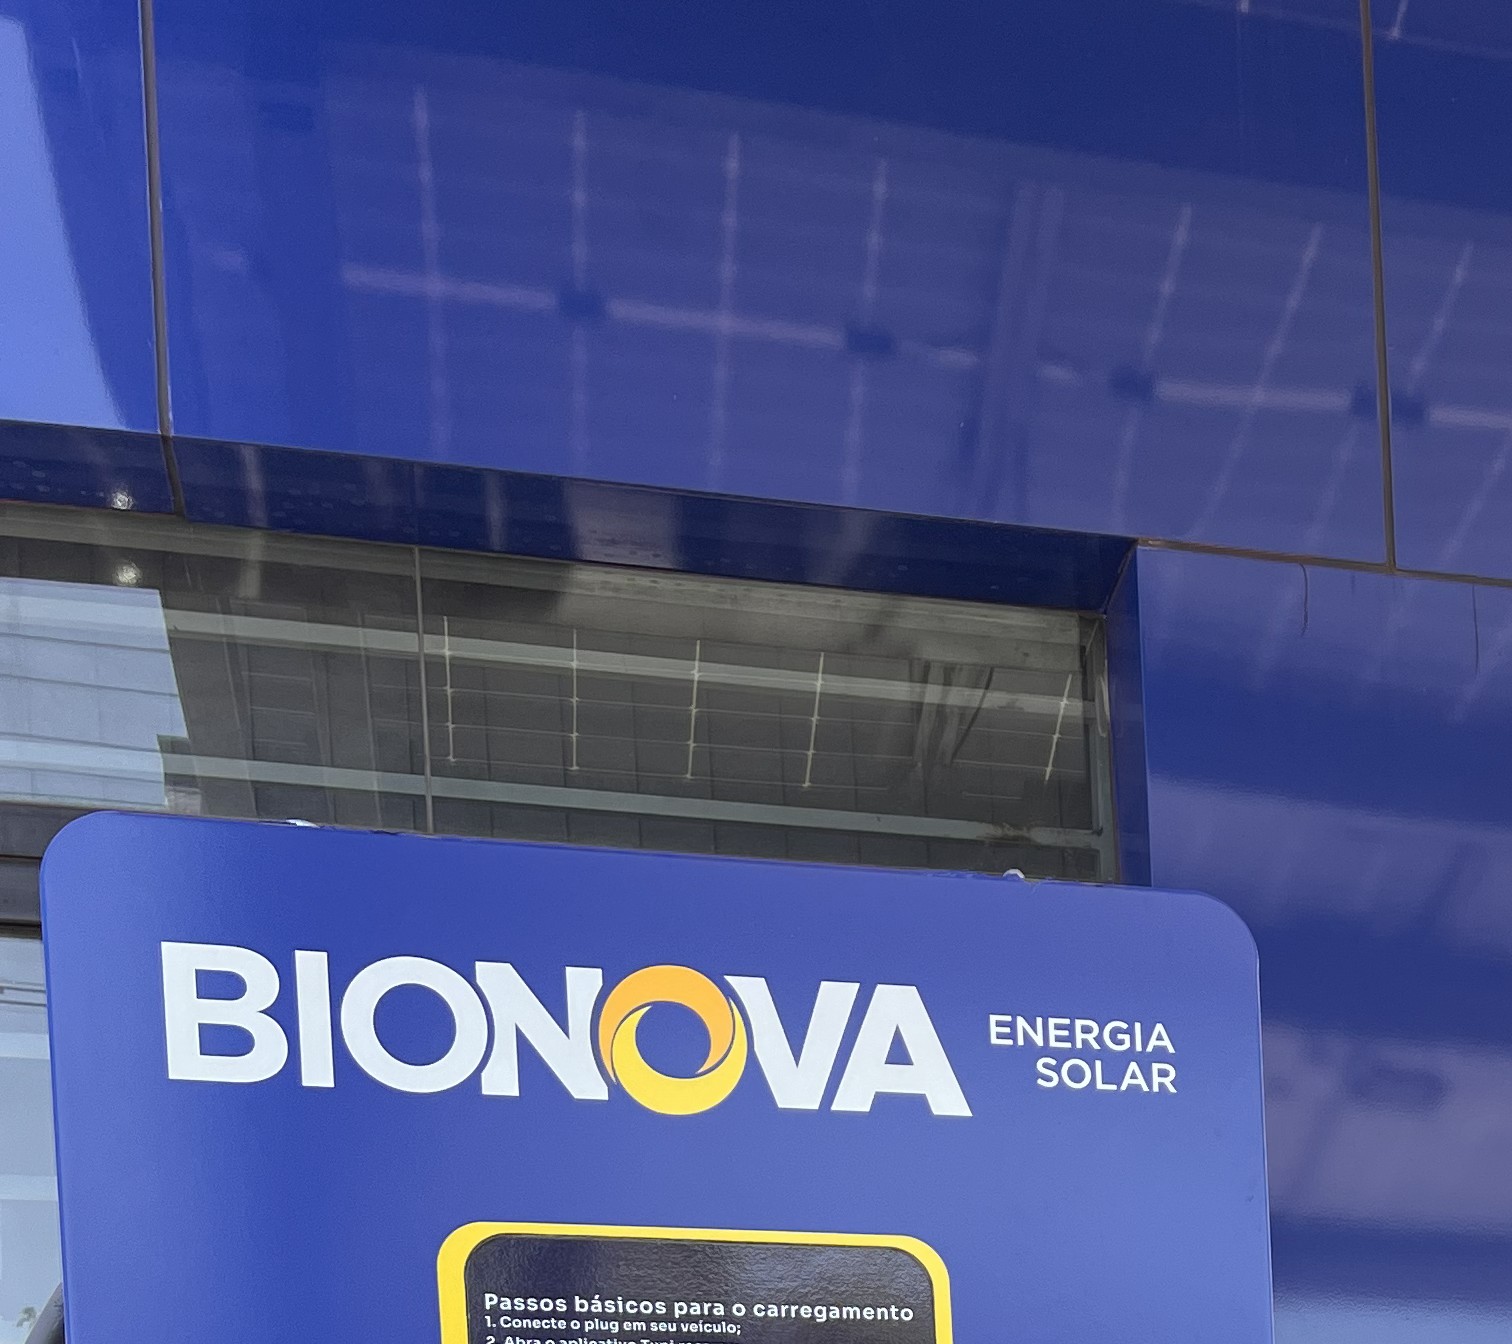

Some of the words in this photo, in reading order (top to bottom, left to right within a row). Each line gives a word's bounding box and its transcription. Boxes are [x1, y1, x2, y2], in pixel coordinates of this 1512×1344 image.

[160, 941, 973, 1116] BIONOVA
[989, 1014, 1176, 1054] ENERGIA
[1036, 1059, 1177, 1093] SOLAR
[484, 1293, 567, 1312] Passos
[574, 1294, 667, 1314] básicos
[674, 1300, 725, 1318] para
[732, 1303, 747, 1317] o
[753, 1303, 914, 1322] carregamento
[484, 1315, 497, 1328] 1.
[500, 1316, 566, 1329] Conecte
[570, 1319, 581, 1330] o
[584, 1318, 619, 1333] plug
[623, 1321, 647, 1331] em
[650, 1322, 677, 1332] seu
[681, 1319, 742, 1336] veículo;
